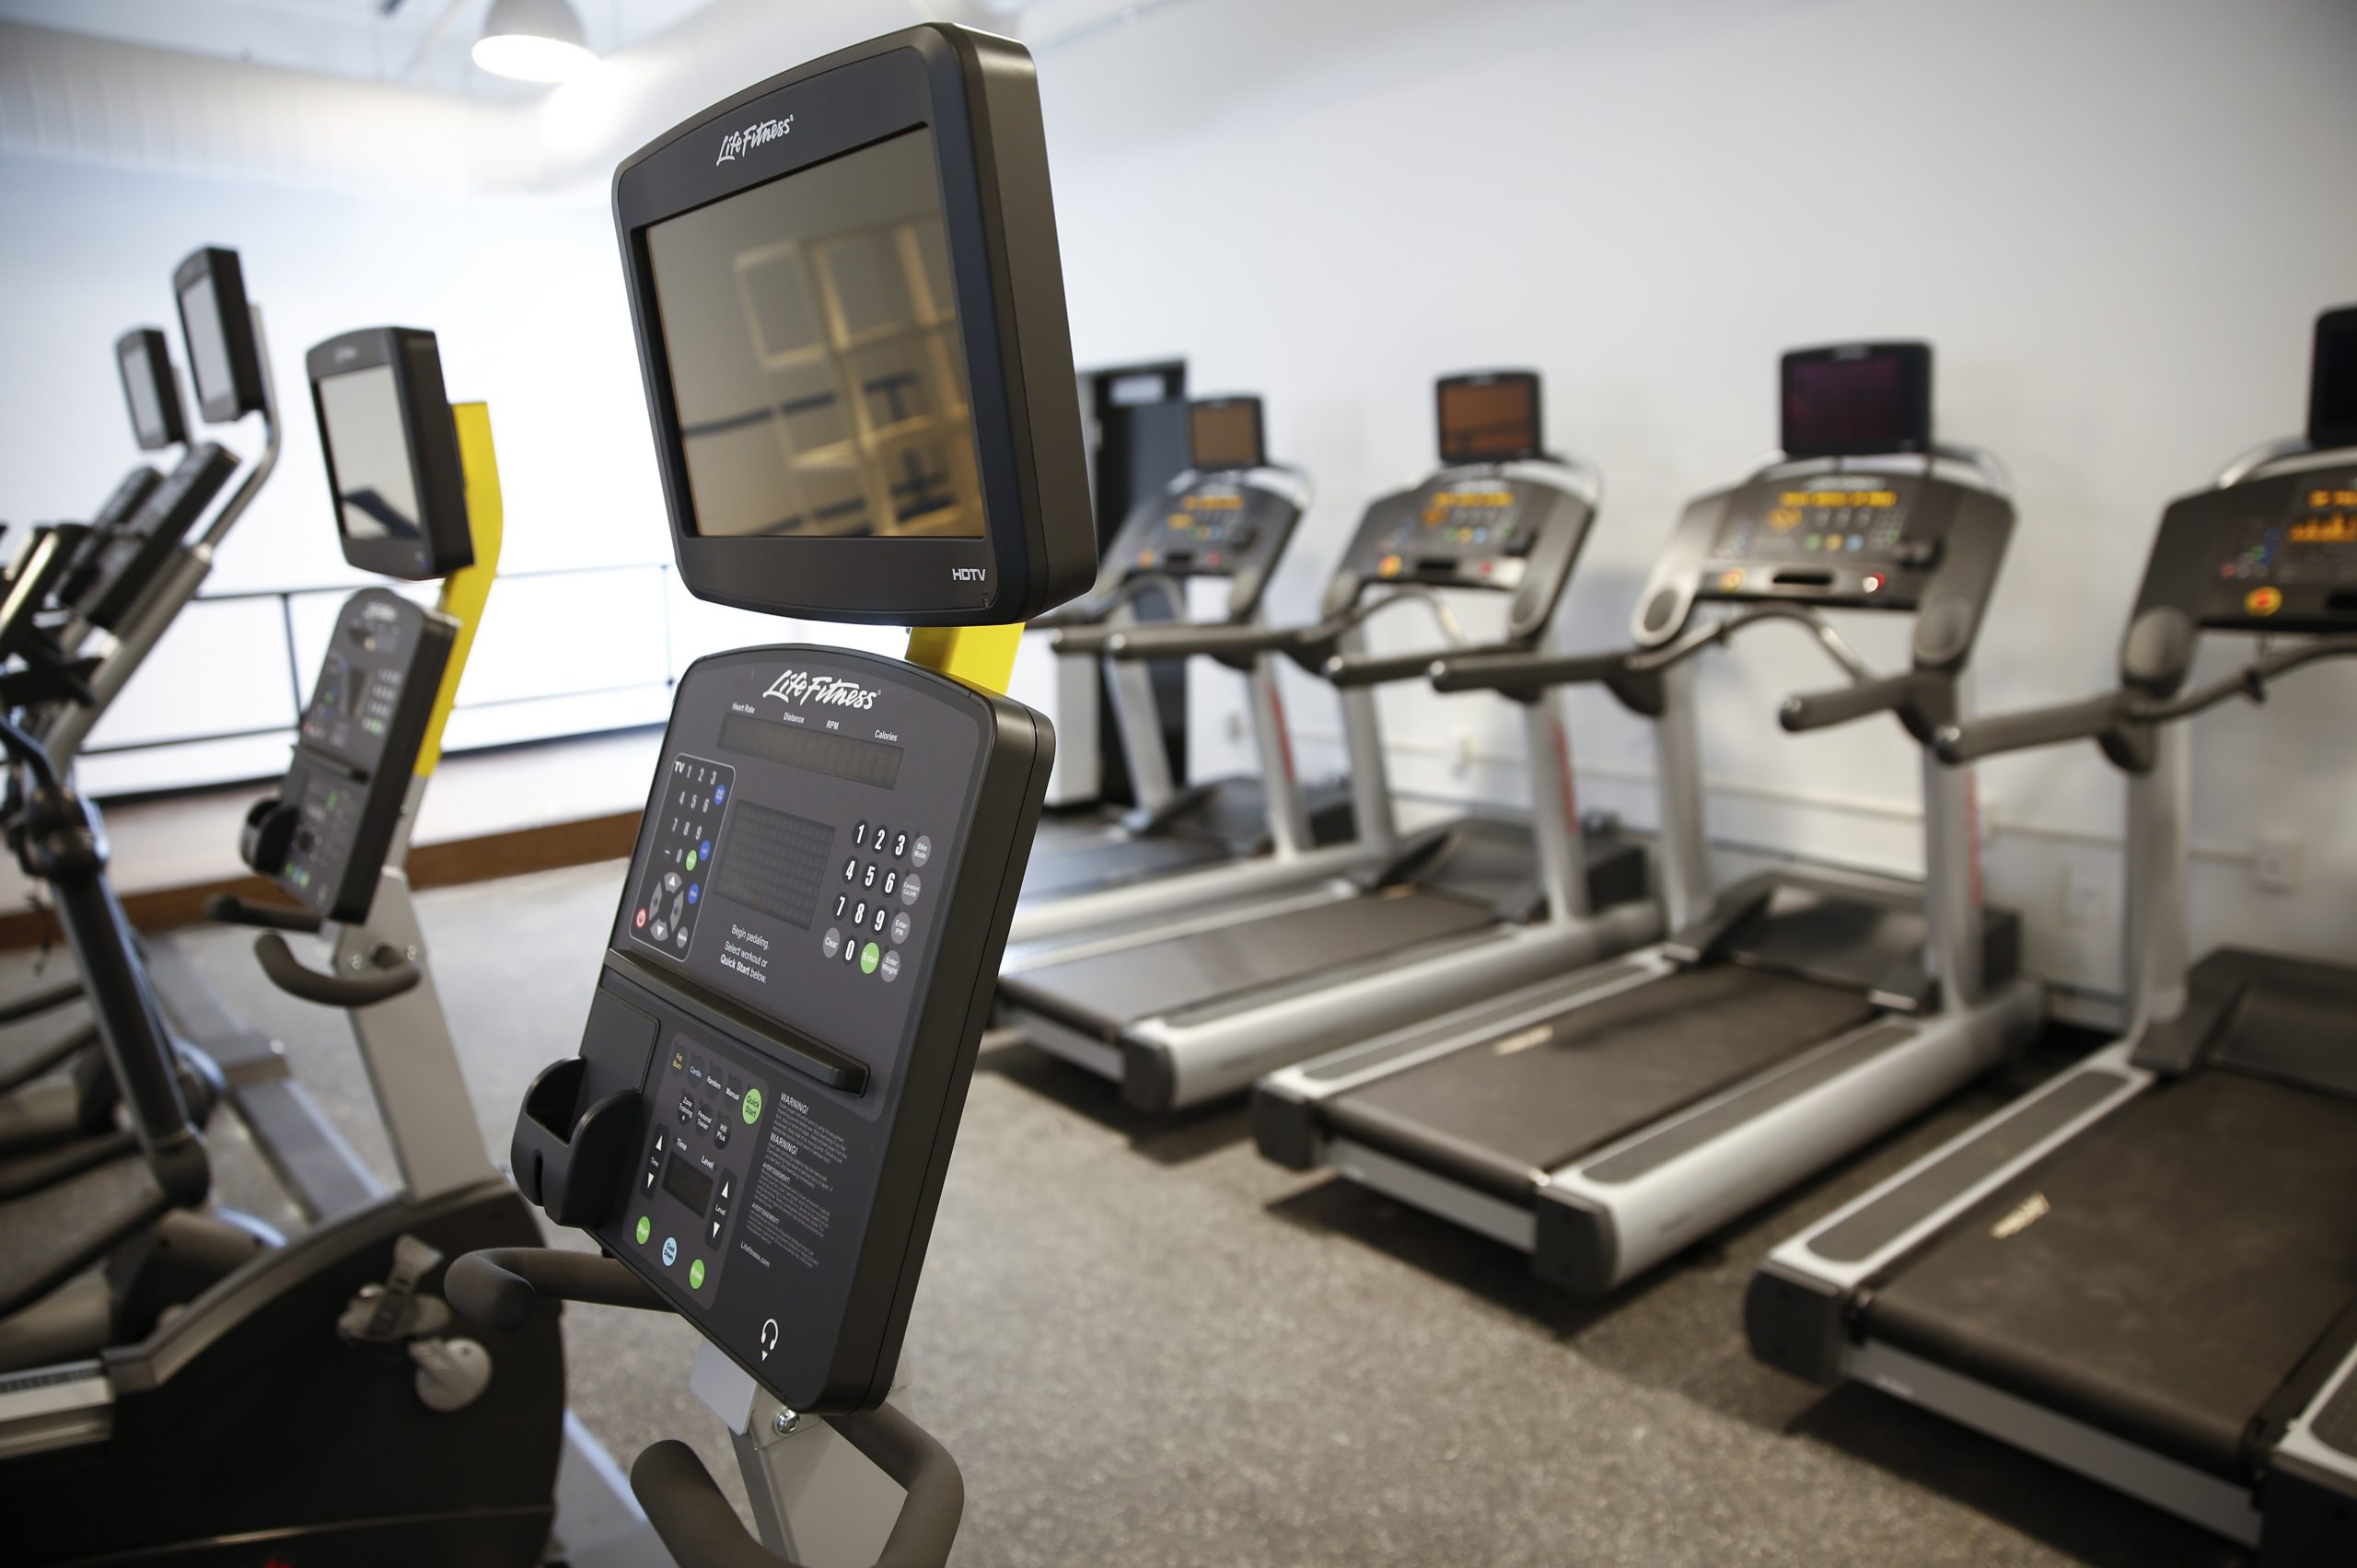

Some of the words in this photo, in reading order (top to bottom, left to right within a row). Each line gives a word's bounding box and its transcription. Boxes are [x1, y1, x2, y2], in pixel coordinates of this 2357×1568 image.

[952, 568, 986, 581] HDTV
[784, 713, 805, 724] Distance
[826, 720, 839, 730] RPM
[875, 730, 898, 742] Calories
[674, 761, 685, 773] TV
[686, 764, 692, 779] 1
[697, 767, 705, 782] 2
[710, 771, 717, 785] 3
[679, 791, 686, 806] 4
[691, 795, 698, 809] 5
[702, 798, 710, 813] 6
[671, 818, 679, 832] 7
[683, 821, 691, 836] 8
[695, 825, 702, 841] 9
[857, 824, 865, 844] 1
[875, 830, 886, 850] 2
[895, 834, 906, 856] 3
[917, 842, 927, 852] Bike
[676, 848, 683, 864] 0
[914, 850, 926, 860] Mode
[845, 860, 856, 880] 4
[865, 865, 876, 887] 5
[885, 872, 896, 894] 6
[837, 896, 846, 917] 7
[854, 902, 865, 924] 8
[875, 910, 886, 931] 9
[895, 920, 908, 929] Enter
[732, 923, 747, 938] Begin
[746, 933, 770, 950] pedaling.
[895, 927, 904, 936] PIN
[725, 941, 740, 956] Select
[741, 948, 761, 966] workout
[761, 959, 768, 968] or
[825, 936, 838, 948] Clear
[845, 939, 854, 960] 0
[863, 952, 877, 963] Enter
[886, 956, 898, 966] Enter
[721, 954, 736, 969] Quick
[737, 961, 750, 976] Start
[750, 968, 767, 983] below.
[882, 962, 898, 975] Weight
[707, 1075, 721, 1089] Random
[726, 1087, 740, 1100] Manual
[682, 1096, 692, 1108] Zone
[747, 1095, 760, 1109] Quick
[781, 1092, 809, 1115] WARNING!
[679, 1102, 693, 1119] Training
[698, 1110, 712, 1123] Personal
[745, 1105, 757, 1118] Start
[698, 1118, 709, 1130] Trainer
[716, 1131, 726, 1142] Plus
[677, 1137, 687, 1151] Time
[770, 1132, 798, 1156] WARNING!
[701, 1155, 714, 1169] Level
[715, 1203, 726, 1216] Level
[664, 1249, 673, 1260] Down
[667, 1243, 675, 1254] Cool
